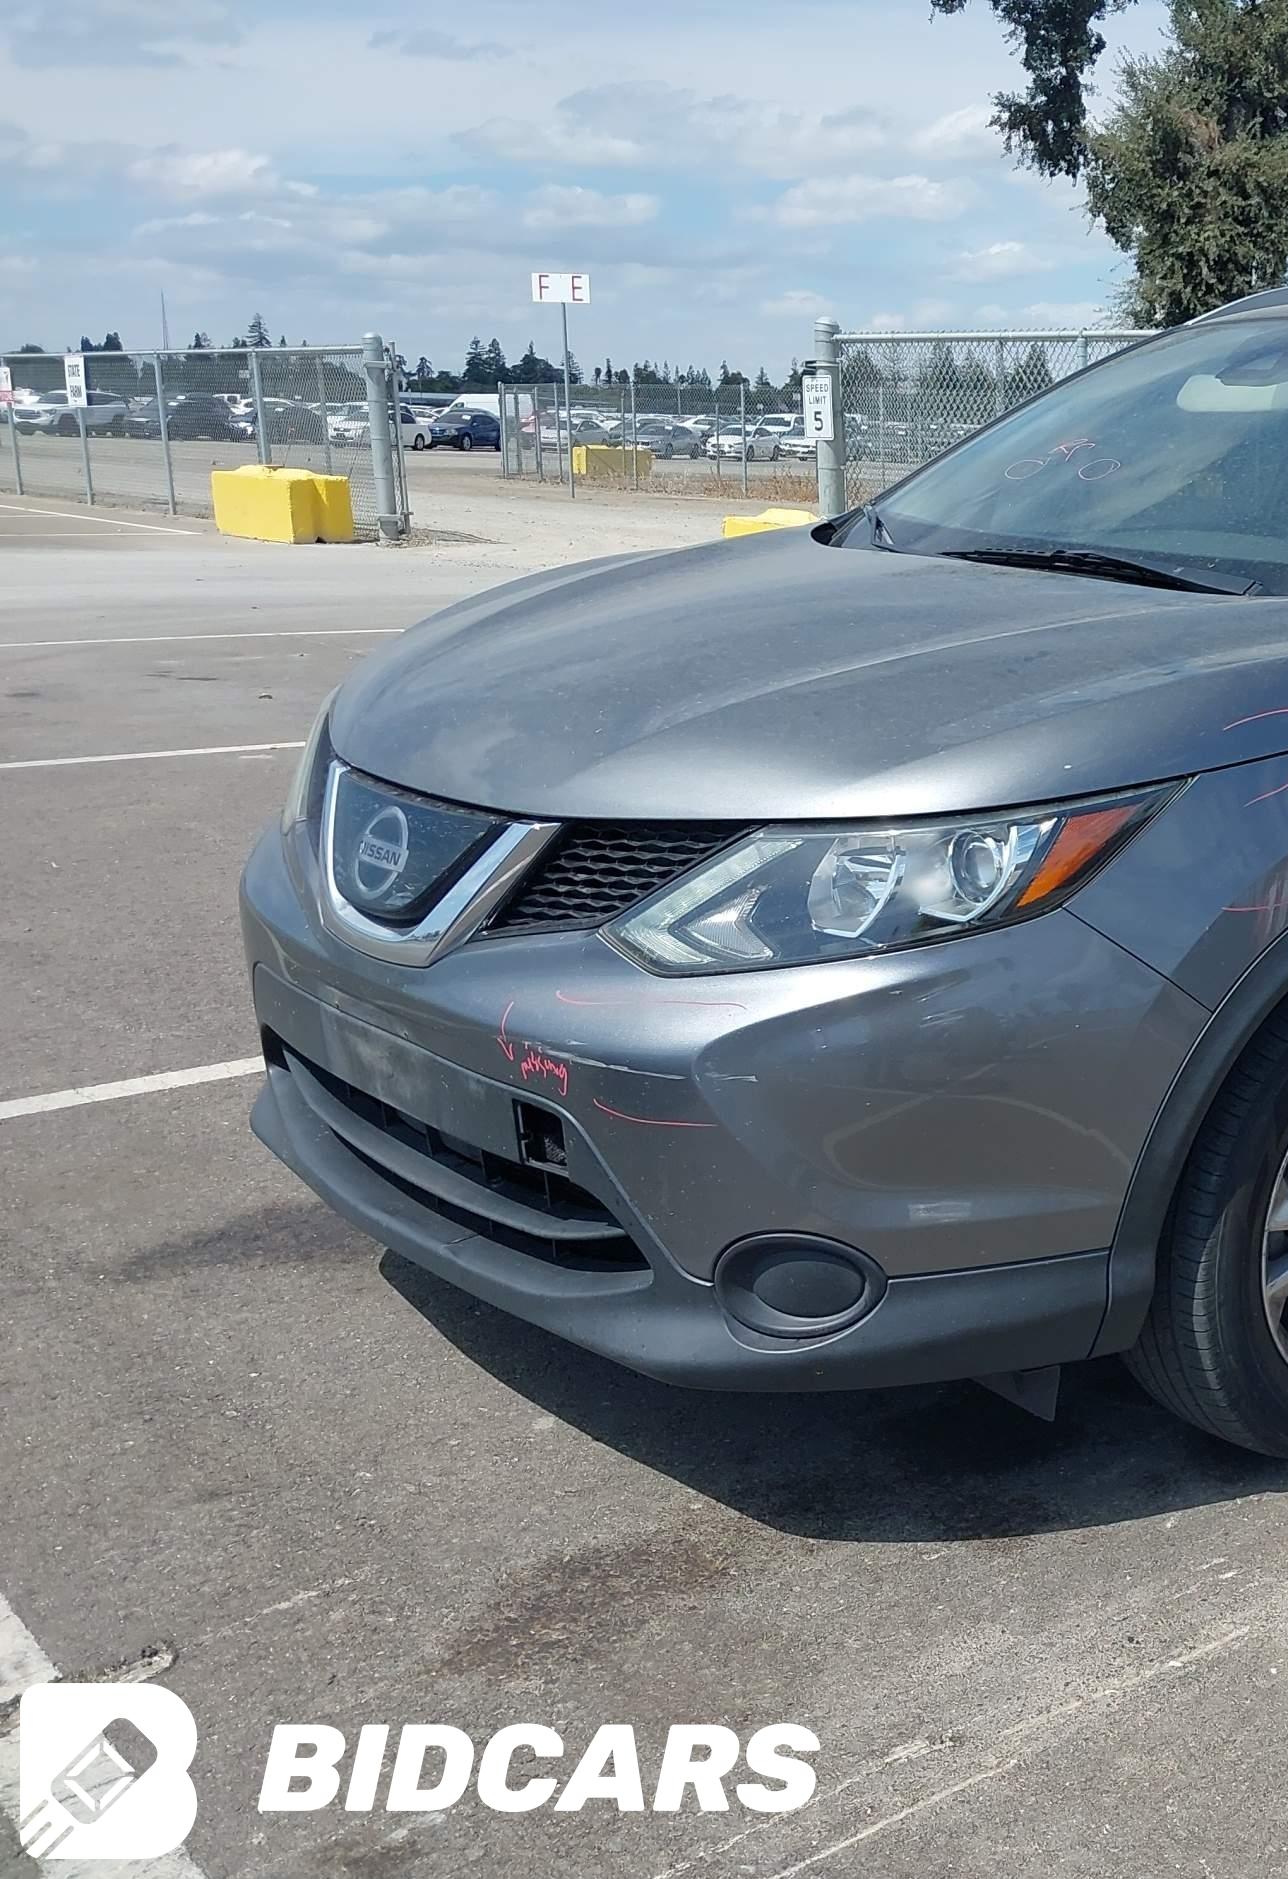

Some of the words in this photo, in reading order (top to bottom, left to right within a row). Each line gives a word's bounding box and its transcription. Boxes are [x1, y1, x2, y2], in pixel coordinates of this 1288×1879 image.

[539, 274, 550, 300] F
[572, 275, 584, 302] E
[805, 383, 829, 393] SPEED
[808, 395, 827, 405] LIMIT
[813, 410, 824, 431] 5
[360, 839, 402, 866] NISSAN
